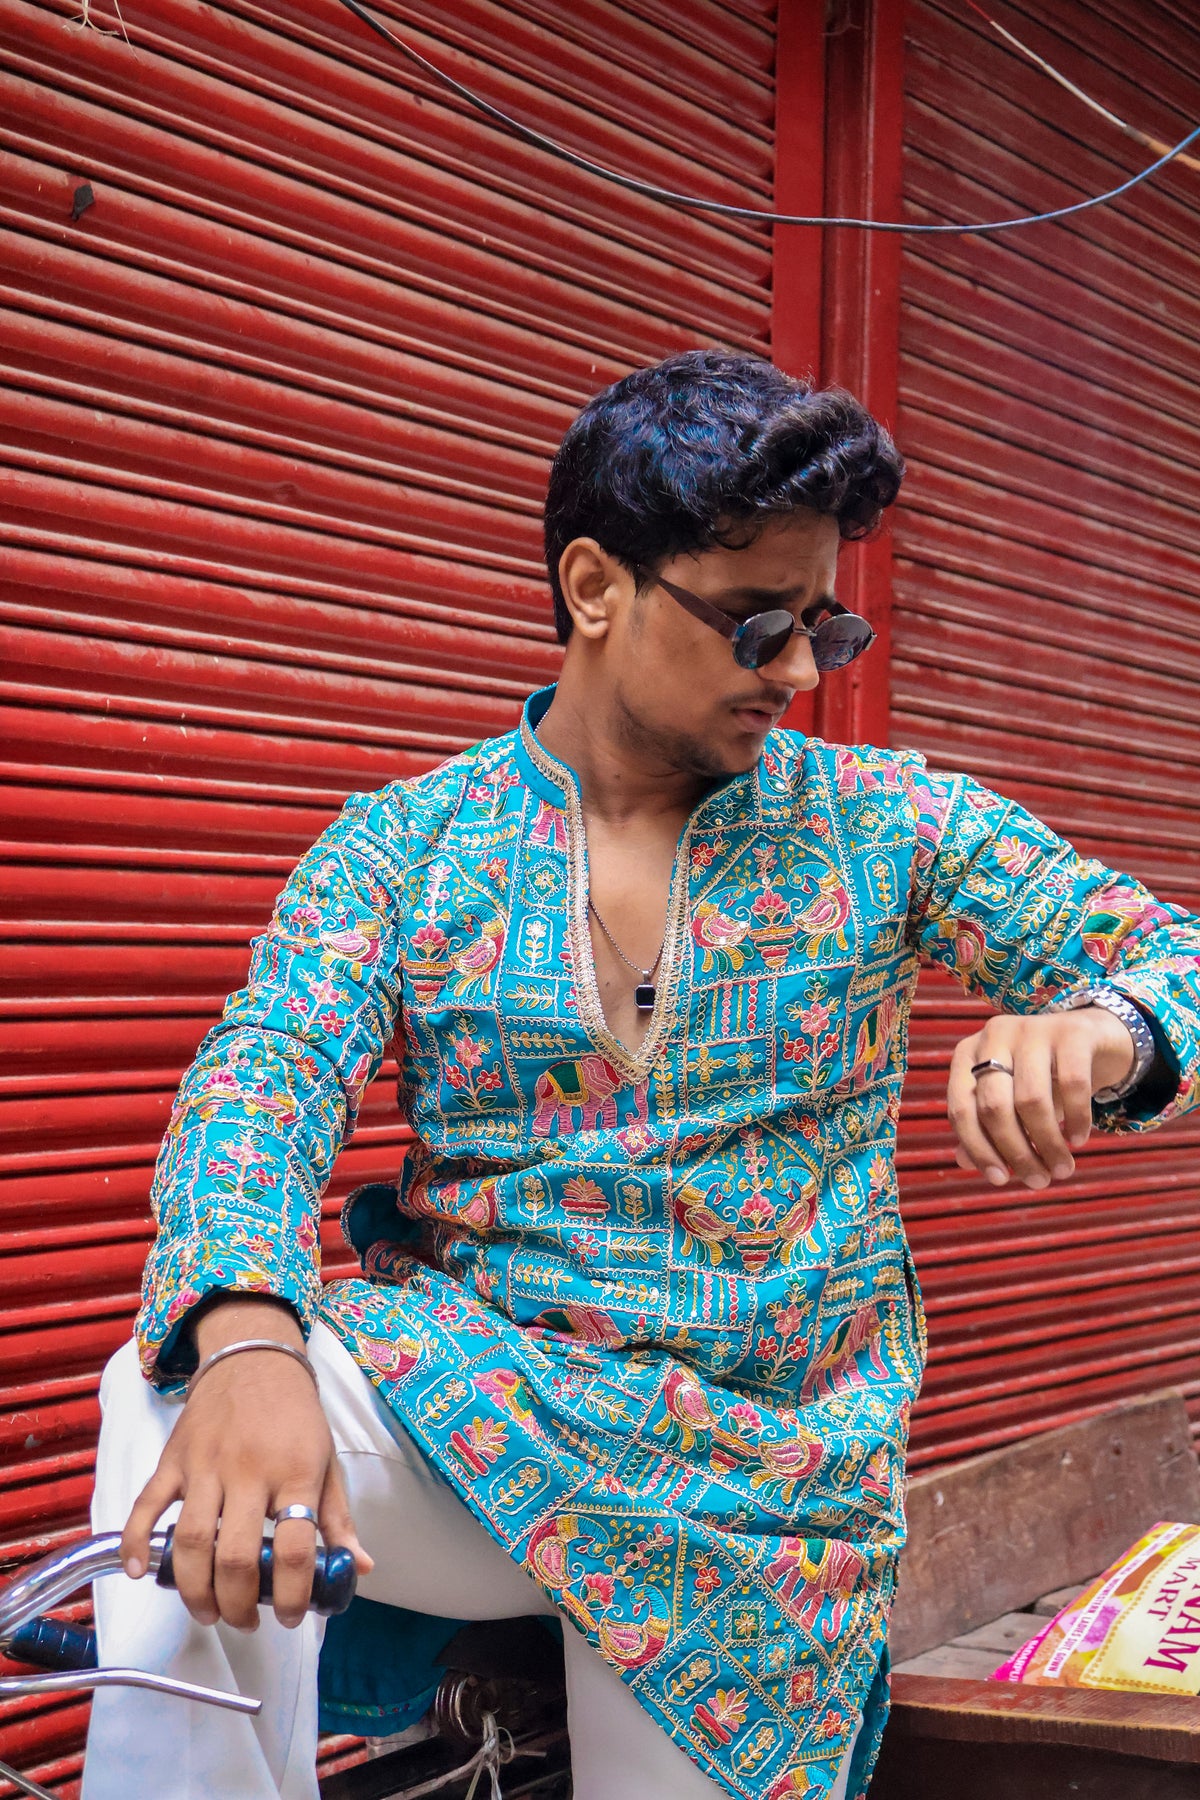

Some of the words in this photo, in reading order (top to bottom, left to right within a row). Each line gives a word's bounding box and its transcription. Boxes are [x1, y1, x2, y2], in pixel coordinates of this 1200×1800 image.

[1147, 1556, 1200, 1622] MART
[1071, 1616, 1093, 1638] LADIES
[1048, 1652, 1066, 1672] GOWN
